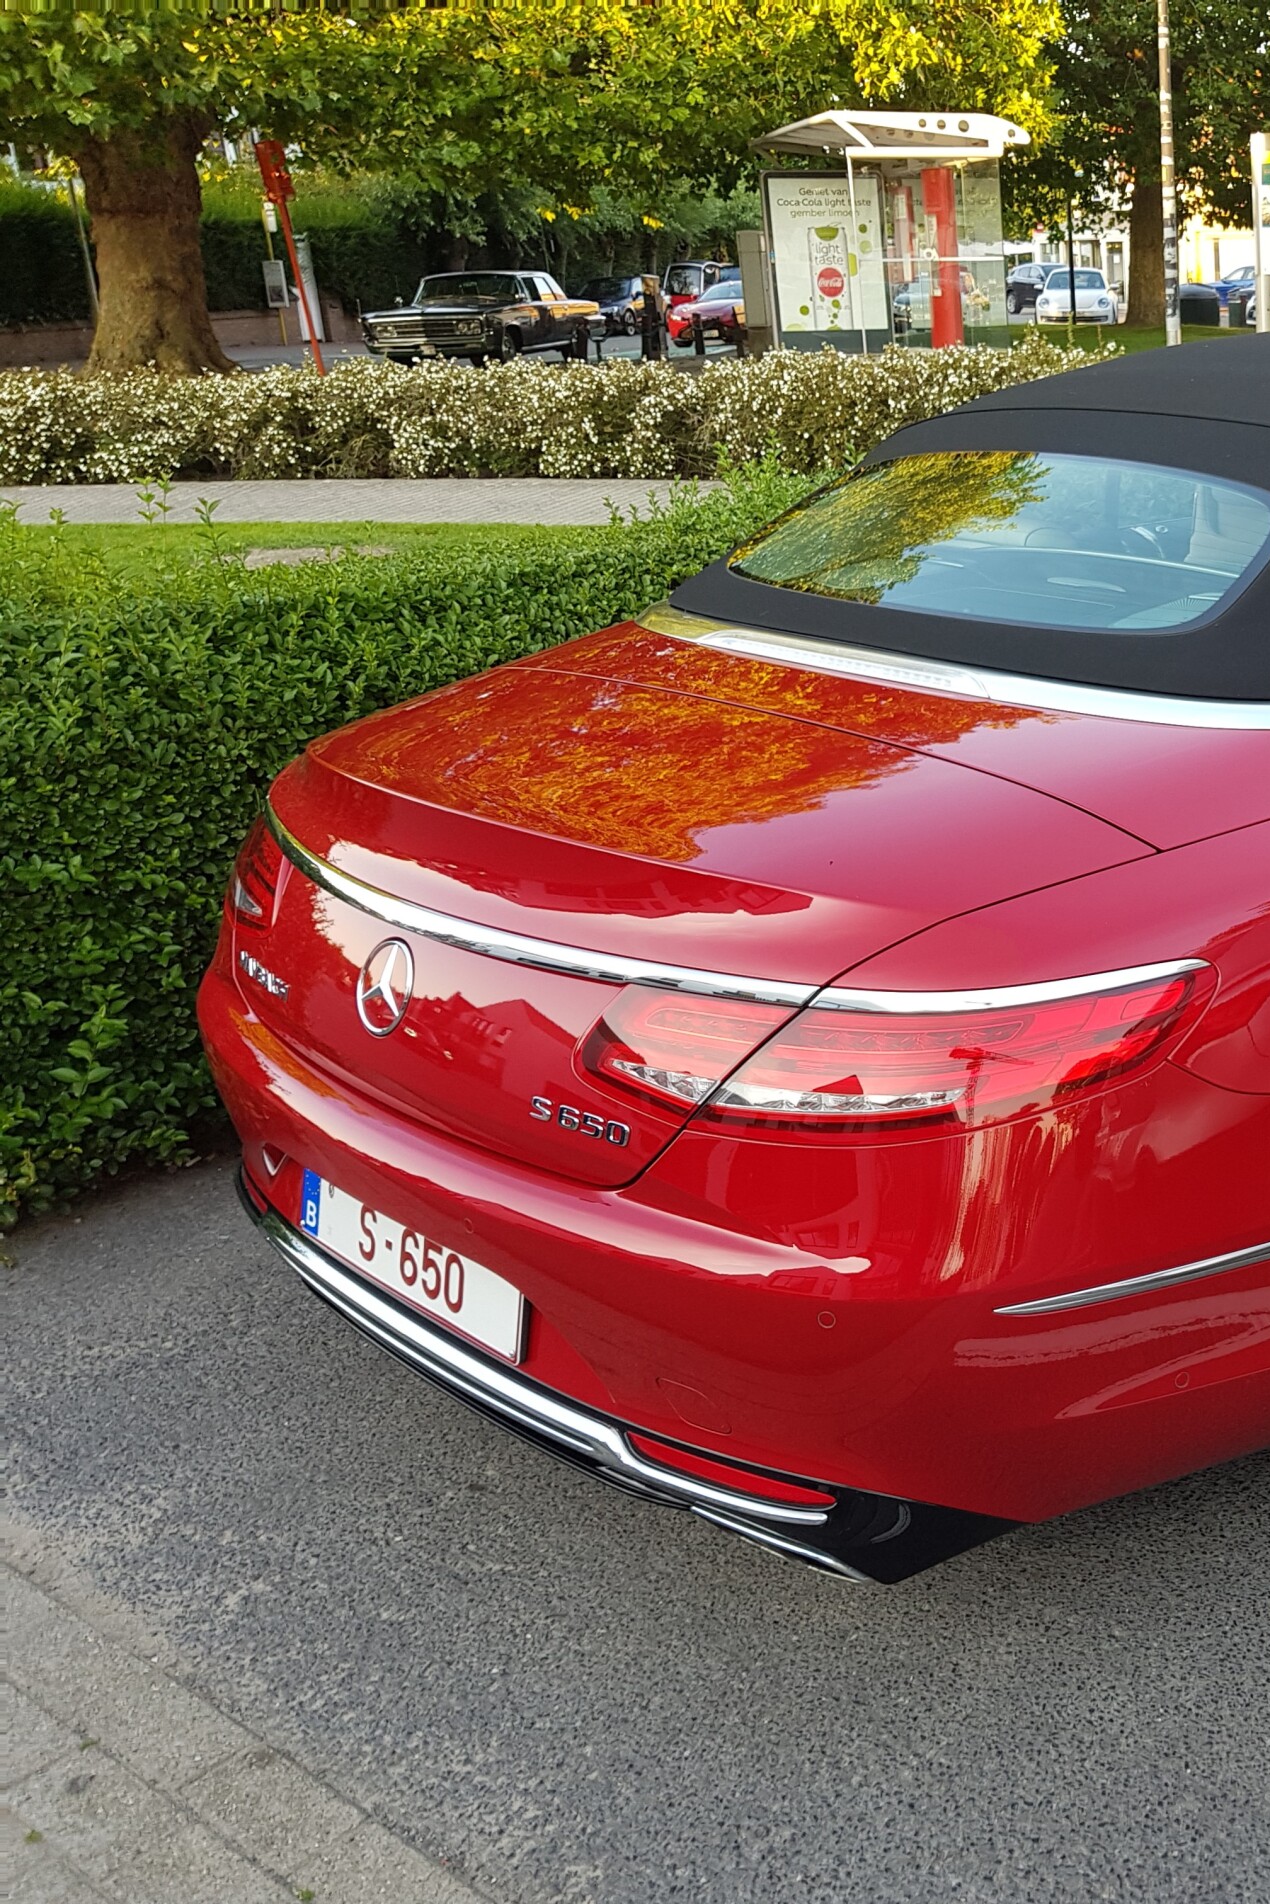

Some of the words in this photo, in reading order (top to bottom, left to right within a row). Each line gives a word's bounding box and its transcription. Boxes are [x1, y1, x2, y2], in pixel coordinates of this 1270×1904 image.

[799, 187, 829, 196] Geniet
[831, 188, 848, 196] van
[825, 198, 846, 208] light
[790, 209, 826, 218] gember
[815, 242, 841, 257] light
[815, 255, 844, 265] taste
[529, 1095, 552, 1122] S
[557, 1104, 631, 1147] 650
[306, 1199, 317, 1228] B
[358, 1203, 465, 1314] S-650
